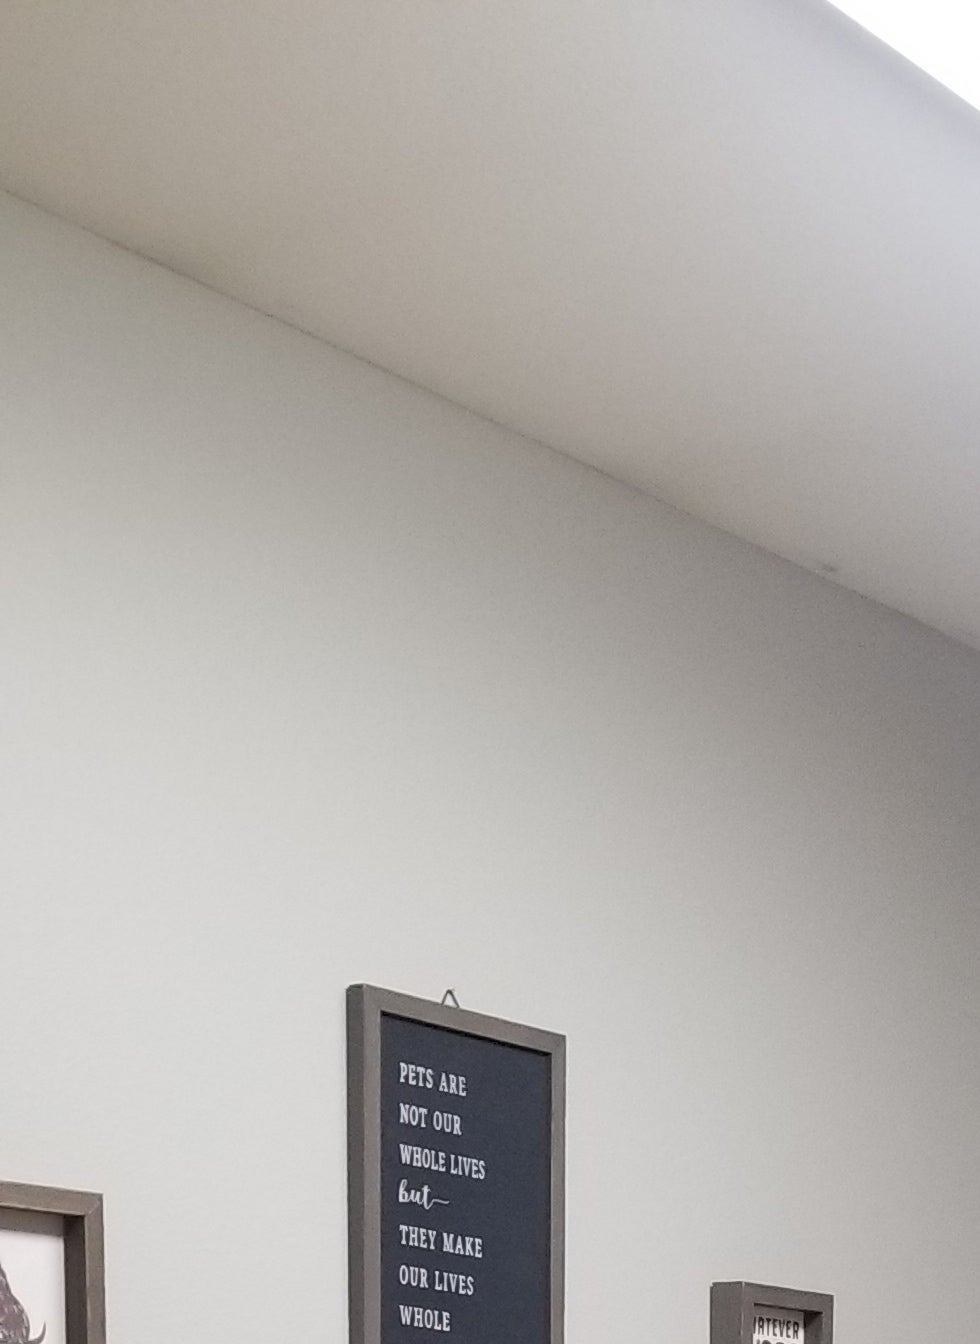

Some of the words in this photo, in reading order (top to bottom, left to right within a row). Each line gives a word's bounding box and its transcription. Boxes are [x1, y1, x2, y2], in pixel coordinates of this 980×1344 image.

[399, 1061, 434, 1089] PETS
[438, 1071, 467, 1097] ARE
[399, 1102, 428, 1128] NOT
[433, 1110, 462, 1136] OUR
[399, 1143, 446, 1172] WHOLE
[450, 1154, 486, 1180] LIVES
[399, 1224, 437, 1250] THEY
[443, 1232, 483, 1259] MAKE
[399, 1265, 429, 1289] OUR
[434, 1270, 475, 1296] LIVES
[399, 1304, 450, 1332] WHOLE
[753, 1315, 800, 1340] ATEVER
